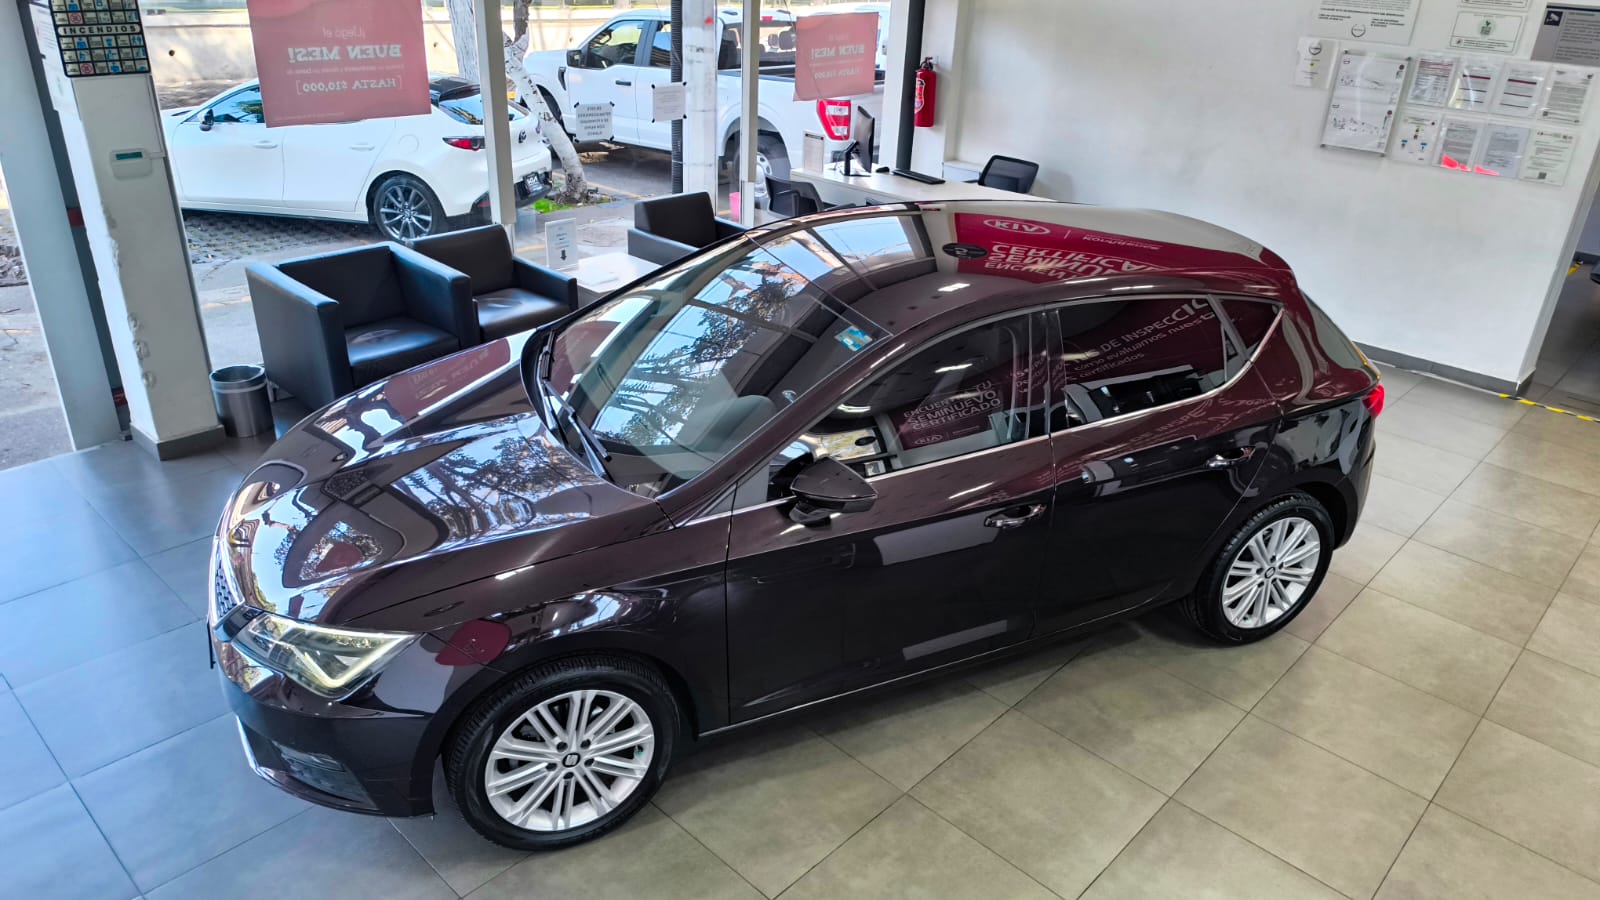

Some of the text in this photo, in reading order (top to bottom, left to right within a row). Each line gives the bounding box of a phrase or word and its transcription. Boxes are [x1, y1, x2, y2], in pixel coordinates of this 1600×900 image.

[63, 25, 137, 35] INCENDIOS
[1100, 338, 1122, 352] DE
[1106, 331, 1168, 362] evaluamos
[1079, 352, 1145, 379] certificados
[907, 390, 997, 424] SEMINUEVO
[911, 398, 1001, 430] CERTIFICADO
